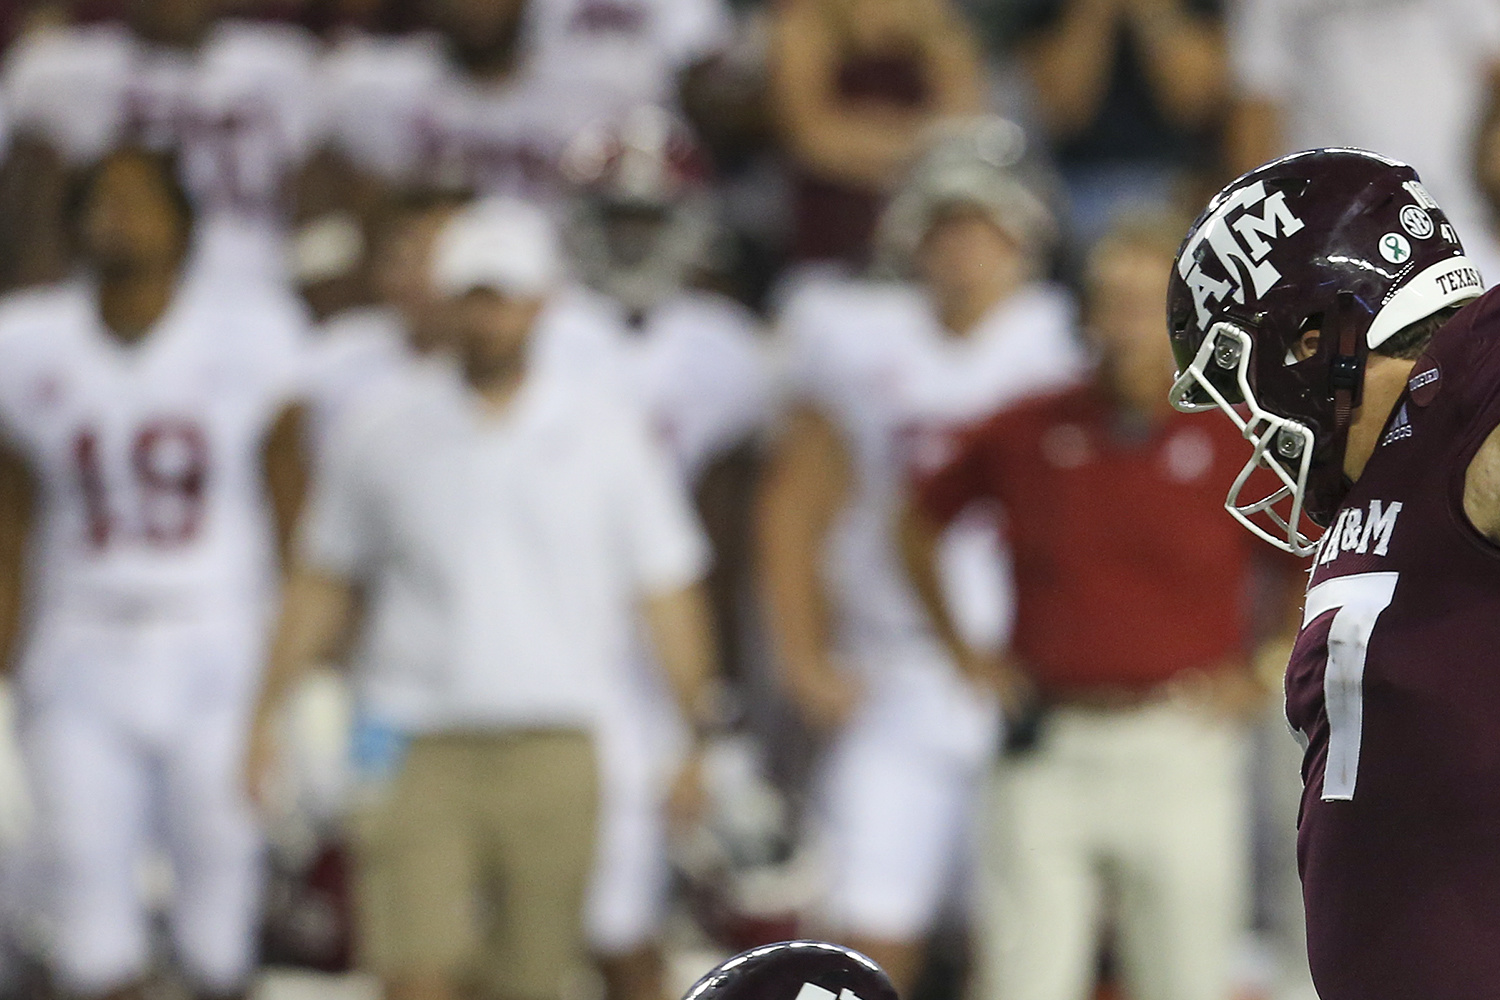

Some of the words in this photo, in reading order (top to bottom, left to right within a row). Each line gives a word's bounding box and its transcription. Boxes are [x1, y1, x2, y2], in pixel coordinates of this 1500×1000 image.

[1402, 206, 1432, 237] SEC
[1436, 268, 1478, 295] TEXAS
[70, 416, 212, 552] 19
